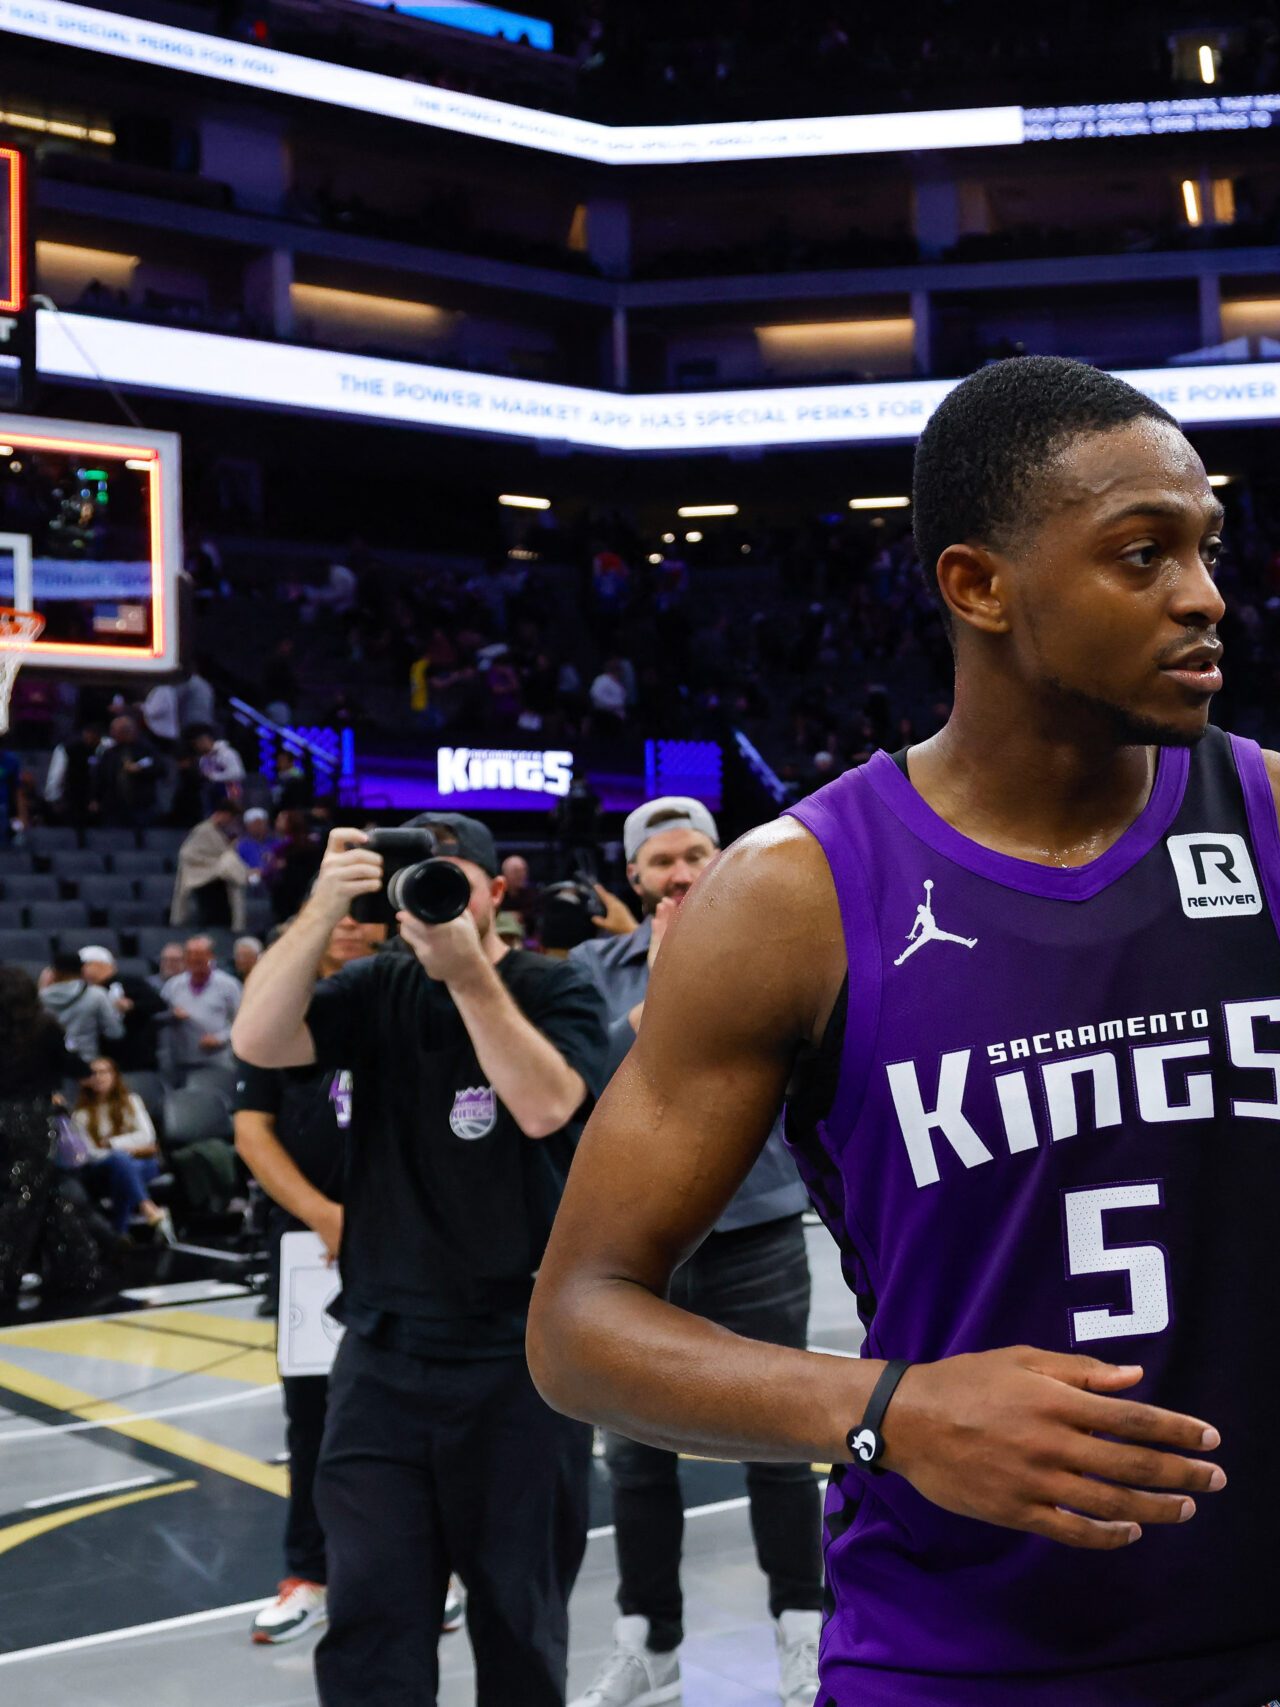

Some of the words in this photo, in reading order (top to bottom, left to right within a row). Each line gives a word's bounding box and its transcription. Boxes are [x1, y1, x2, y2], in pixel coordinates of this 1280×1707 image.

[338, 372, 385, 397] THE
[393, 380, 482, 408] POWER
[489, 396, 582, 422] MARKET
[640, 411, 687, 428] HAS
[694, 408, 787, 427] SPECIAL
[797, 402, 869, 422] PERKS
[878, 399, 924, 417] FOR
[1145, 386, 1180, 404] HE
[1188, 380, 1276, 402] POWER
[1189, 843, 1242, 885] R
[1187, 894, 1257, 908] REVIVER
[987, 1008, 1209, 1065] SACRAMENTO
[1064, 1183, 1170, 1342] 5
